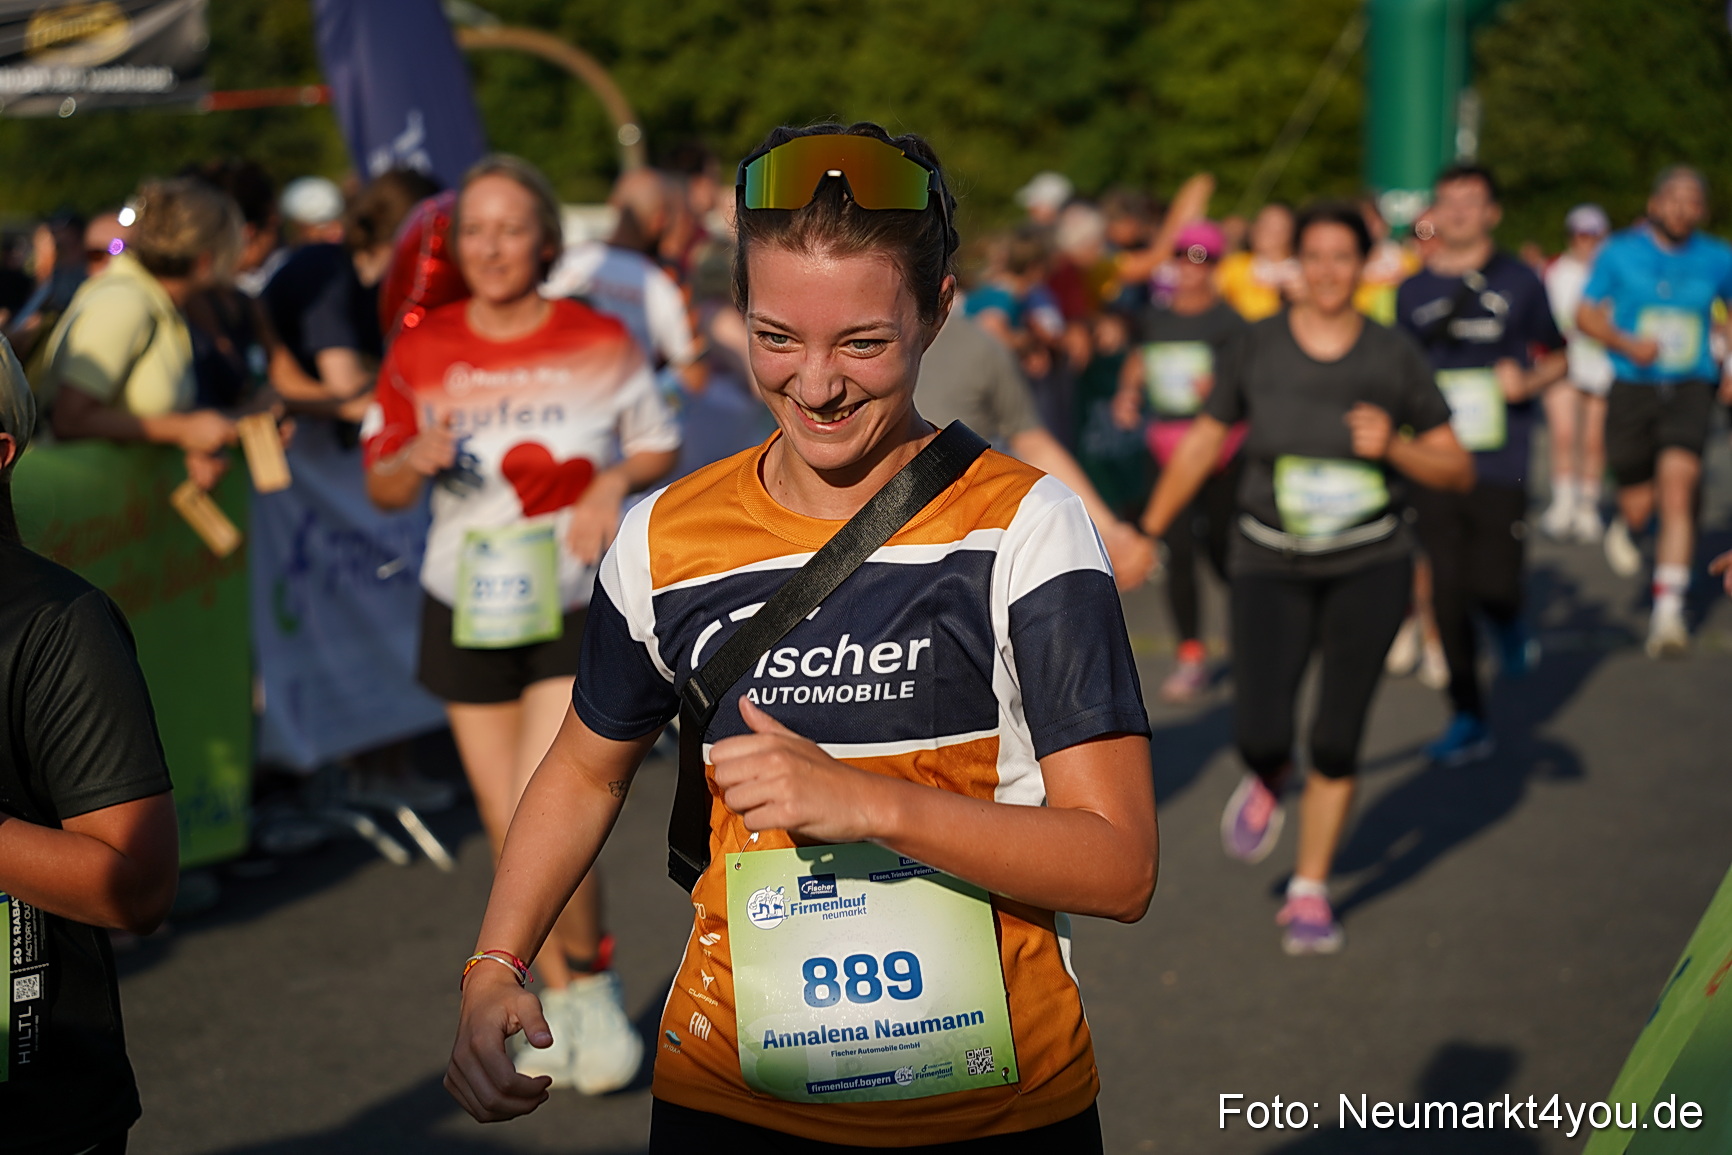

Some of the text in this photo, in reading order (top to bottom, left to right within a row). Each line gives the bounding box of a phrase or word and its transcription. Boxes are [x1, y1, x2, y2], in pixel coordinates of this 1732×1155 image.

[752, 633, 931, 679] ischer
[746, 680, 915, 705] AUTOMOBILE
[872, 873, 891, 881] Essen,
[891, 870, 913, 878] Trinken,
[806, 880, 835, 892] Fischer
[790, 893, 867, 916] Firmenlauf
[822, 906, 867, 921] neumarkt
[25, 920, 33, 963] FACTORY
[13, 947, 22, 966] 20
[802, 950, 924, 1008] 889
[688, 987, 719, 1007] CUPRA
[18, 1005, 32, 1065] HILTL
[762, 1009, 985, 1050] Annalena Naumann
[830, 1041, 921, 1058] Fischer Automobile GmbH
[915, 1065, 953, 1080] Firmenlauf
[811, 1075, 892, 1093] firmenlauf.bayern
